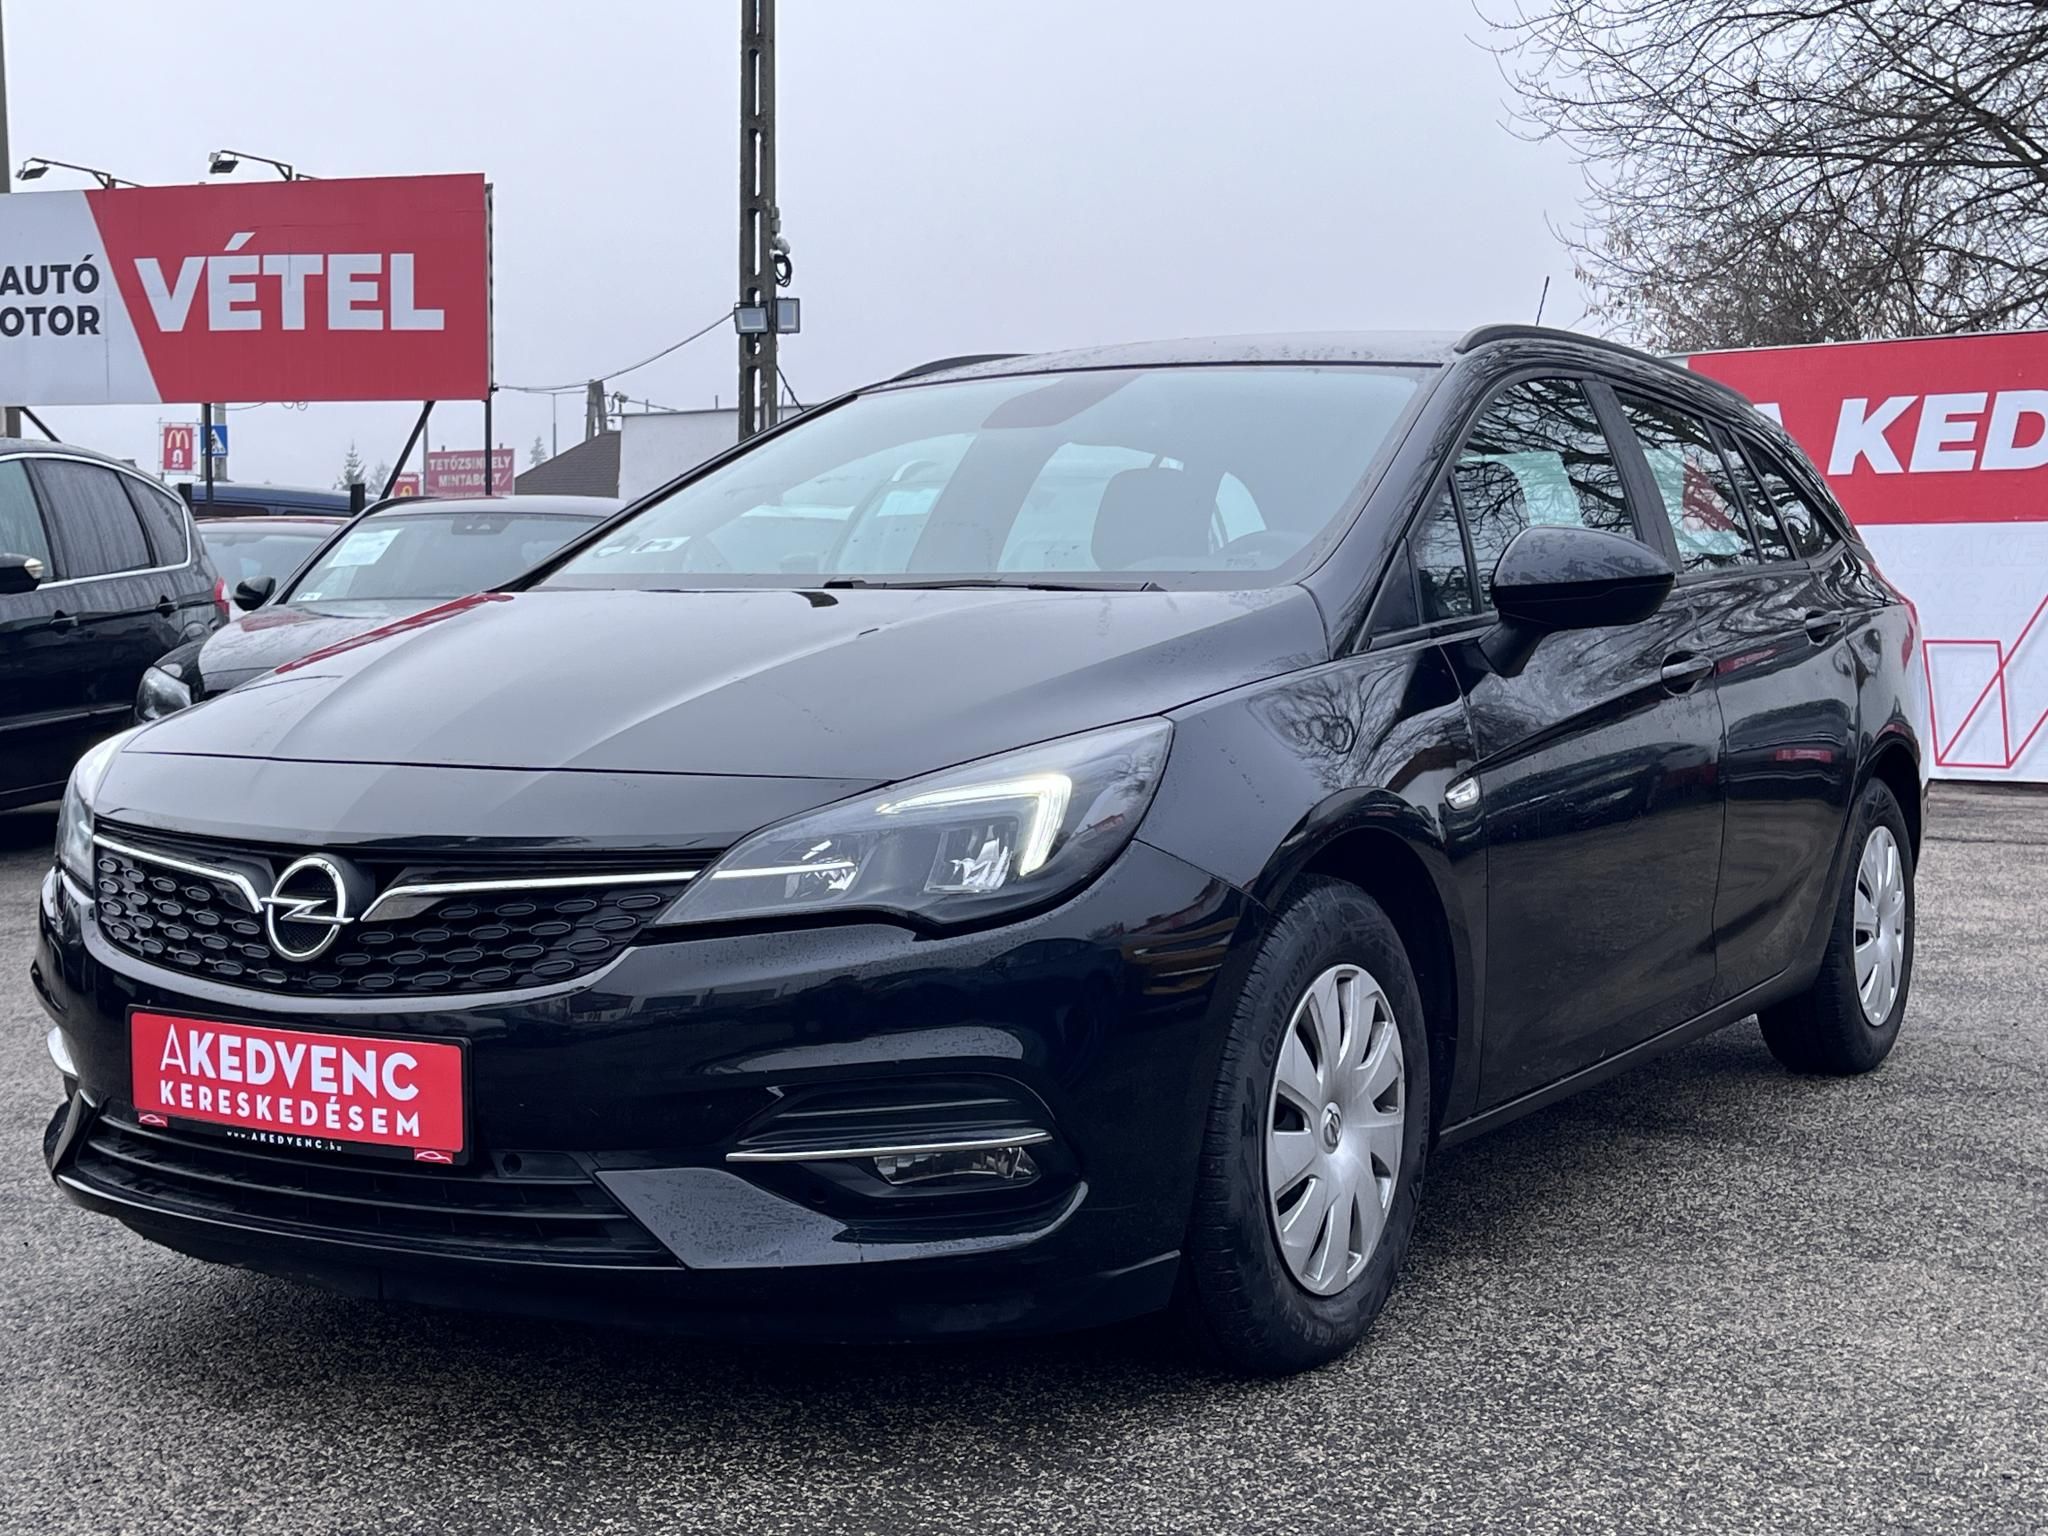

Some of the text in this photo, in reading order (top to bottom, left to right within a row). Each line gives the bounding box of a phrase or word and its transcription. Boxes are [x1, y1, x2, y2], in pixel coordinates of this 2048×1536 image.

[0, 254, 100, 296] AUTÓ
[134, 231, 445, 332] VÉTEL
[0, 305, 101, 337] OTOR
[429, 455, 512, 471] TETŐZSINELY
[438, 473, 502, 488] MINTABOT
[159, 1080, 421, 1137] KERESKEDÉSEM
